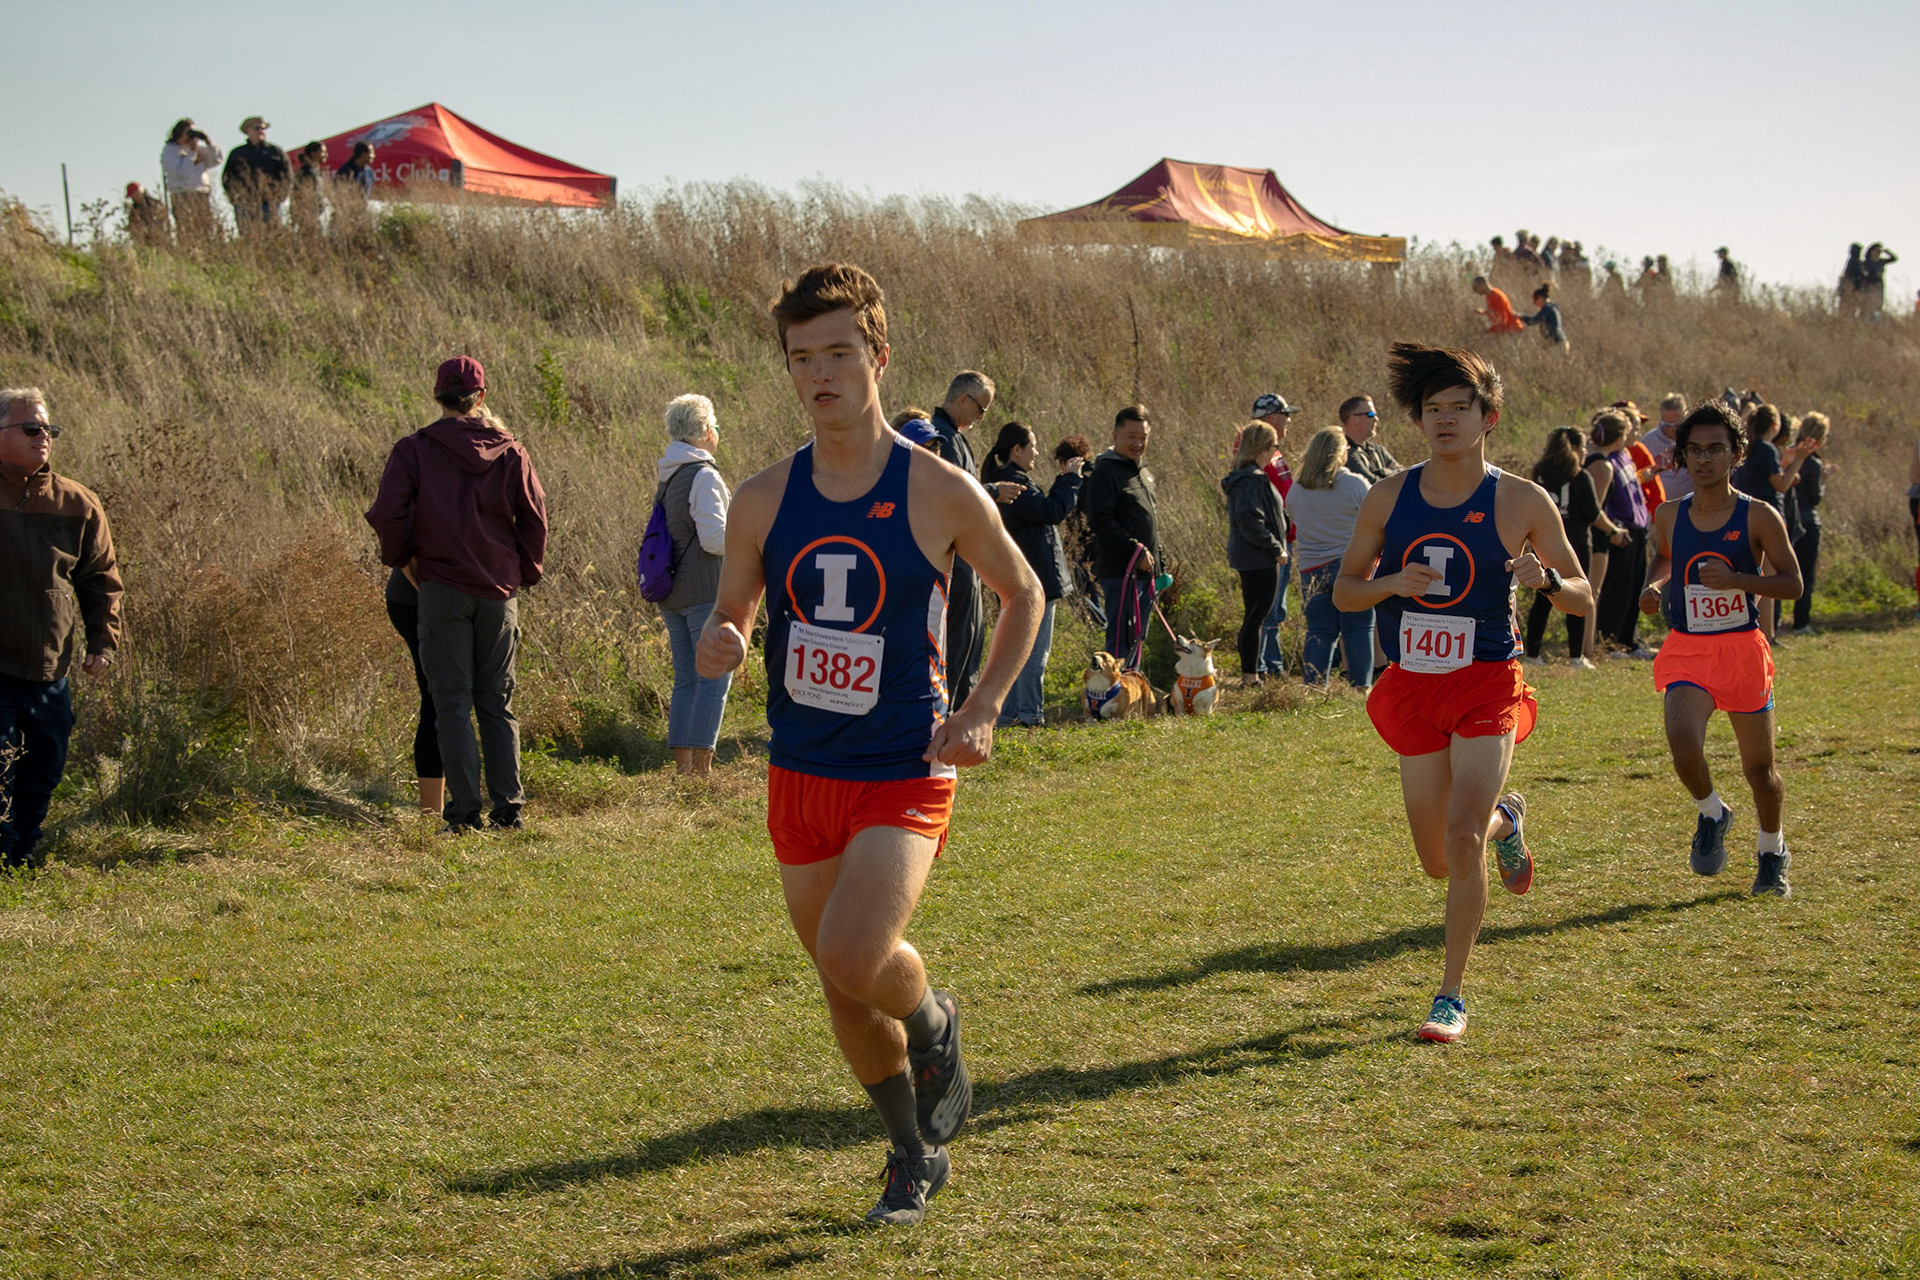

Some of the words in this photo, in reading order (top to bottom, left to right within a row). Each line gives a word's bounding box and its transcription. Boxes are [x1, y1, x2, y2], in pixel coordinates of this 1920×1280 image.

[395, 162, 436, 182] Club
[1689, 593, 1745, 619] 1364
[1402, 627, 1466, 660] 1401
[792, 643, 876, 694] 1382
